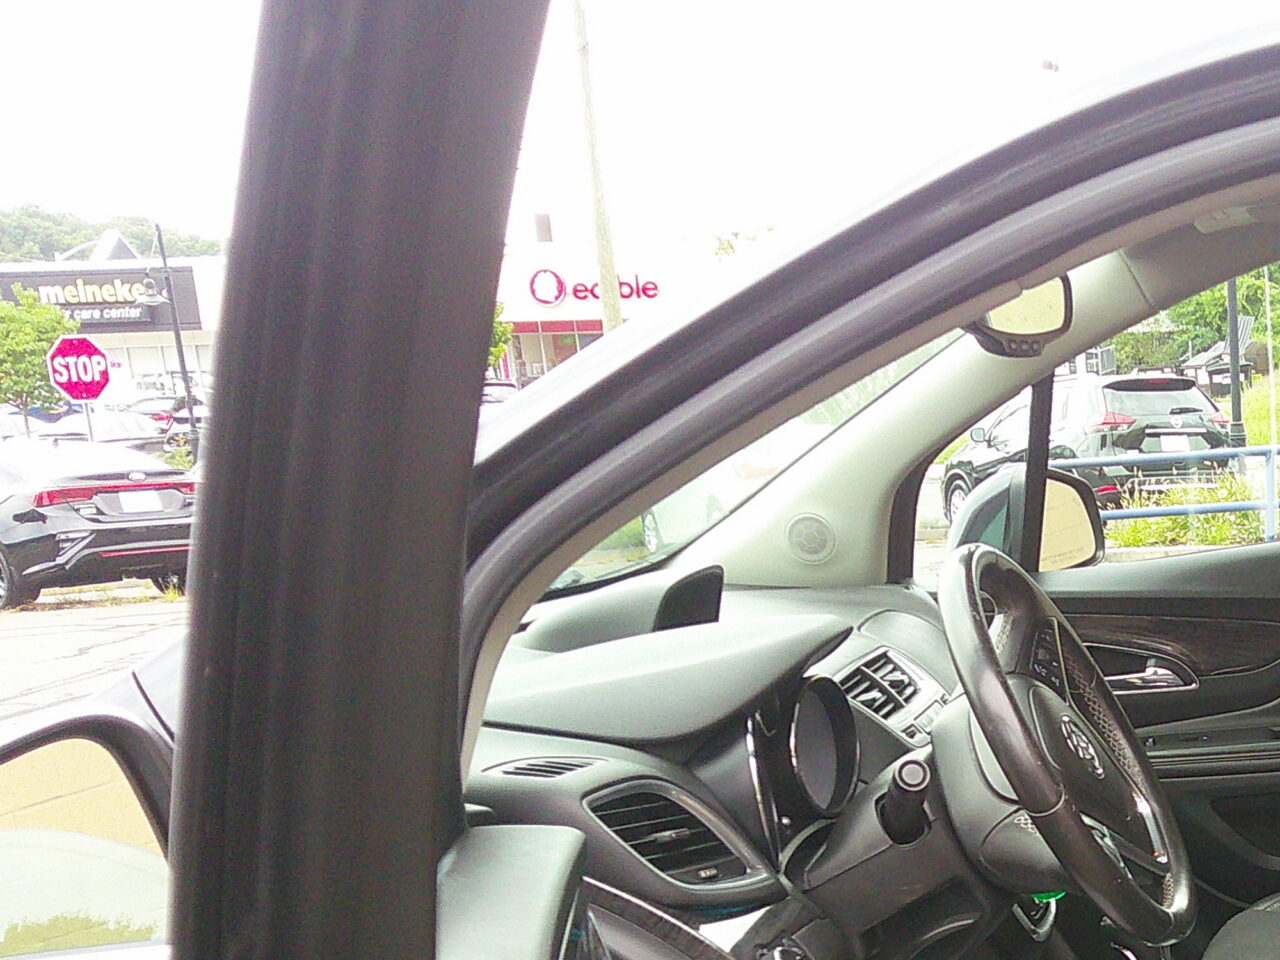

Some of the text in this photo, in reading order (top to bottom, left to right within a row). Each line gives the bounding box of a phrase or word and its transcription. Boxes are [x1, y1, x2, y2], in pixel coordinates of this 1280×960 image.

[38, 279, 147, 304] meineke
[572, 274, 659, 300] eble
[74, 308, 101, 319] care
[103, 307, 141, 318] center
[53, 355, 106, 383] STOP
